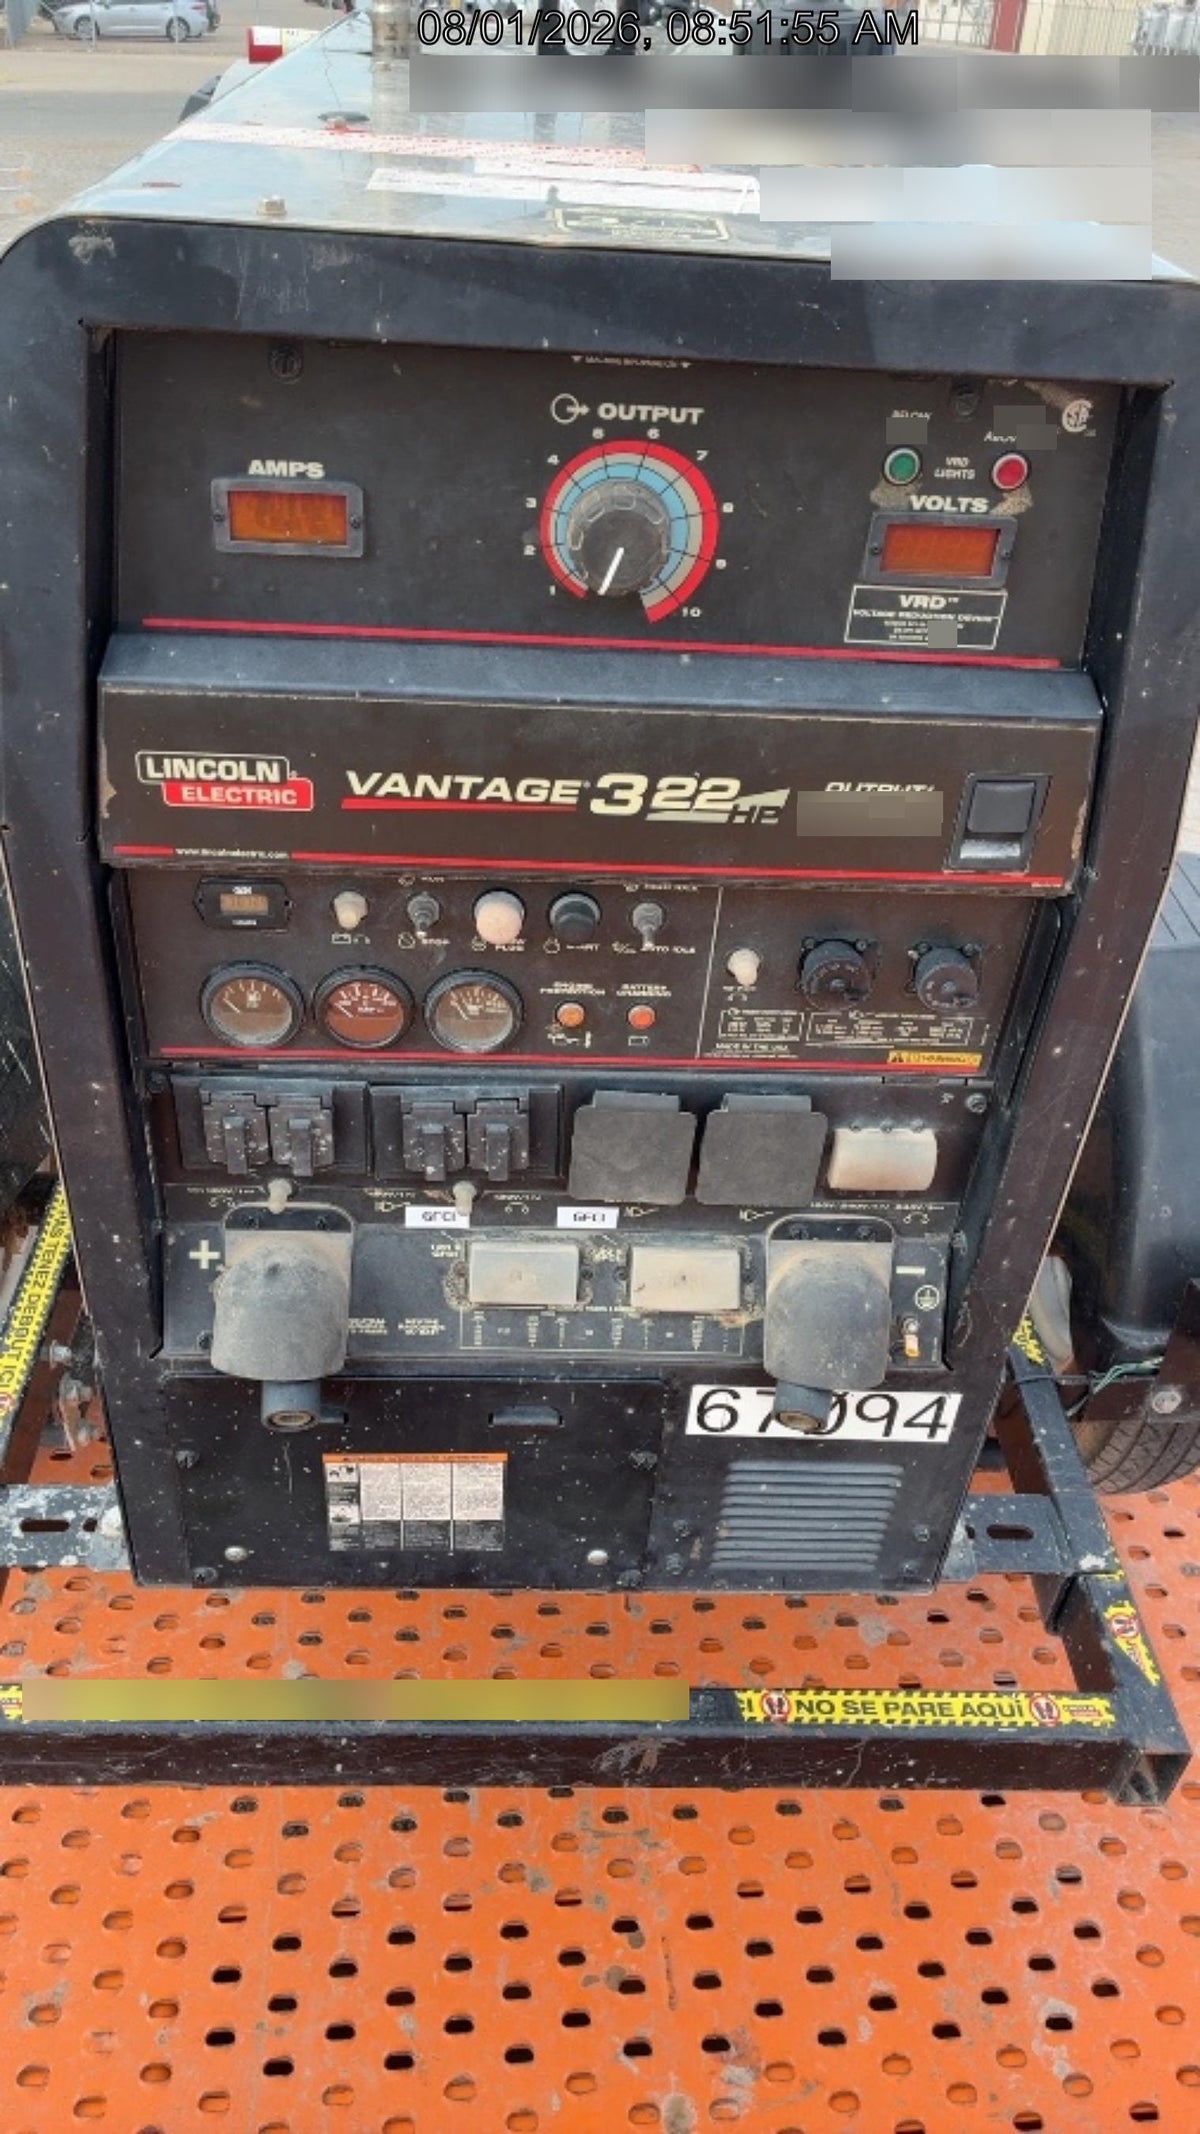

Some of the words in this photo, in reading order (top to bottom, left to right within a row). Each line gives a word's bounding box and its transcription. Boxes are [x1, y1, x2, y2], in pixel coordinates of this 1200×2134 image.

[597, 402, 704, 425] OUTPUT
[547, 454, 560, 466] 4
[696, 450, 709, 461] 7
[248, 459, 326, 480] AMPS
[525, 497, 537, 509] 3
[909, 494, 990, 513] VOLTS
[524, 544, 536, 556] 2
[681, 606, 702, 618] 10
[146, 756, 281, 784] LINCOLN
[180, 785, 298, 806] ELECTRIC
[589, 772, 741, 817] 322
[33, 1239, 60, 1290] TENEZ
[8, 1293, 42, 1362] DEBOUT
[796, 1700, 835, 1715] NO
[842, 1700, 878, 1715] SE
[885, 1701, 954, 1717] PARE
